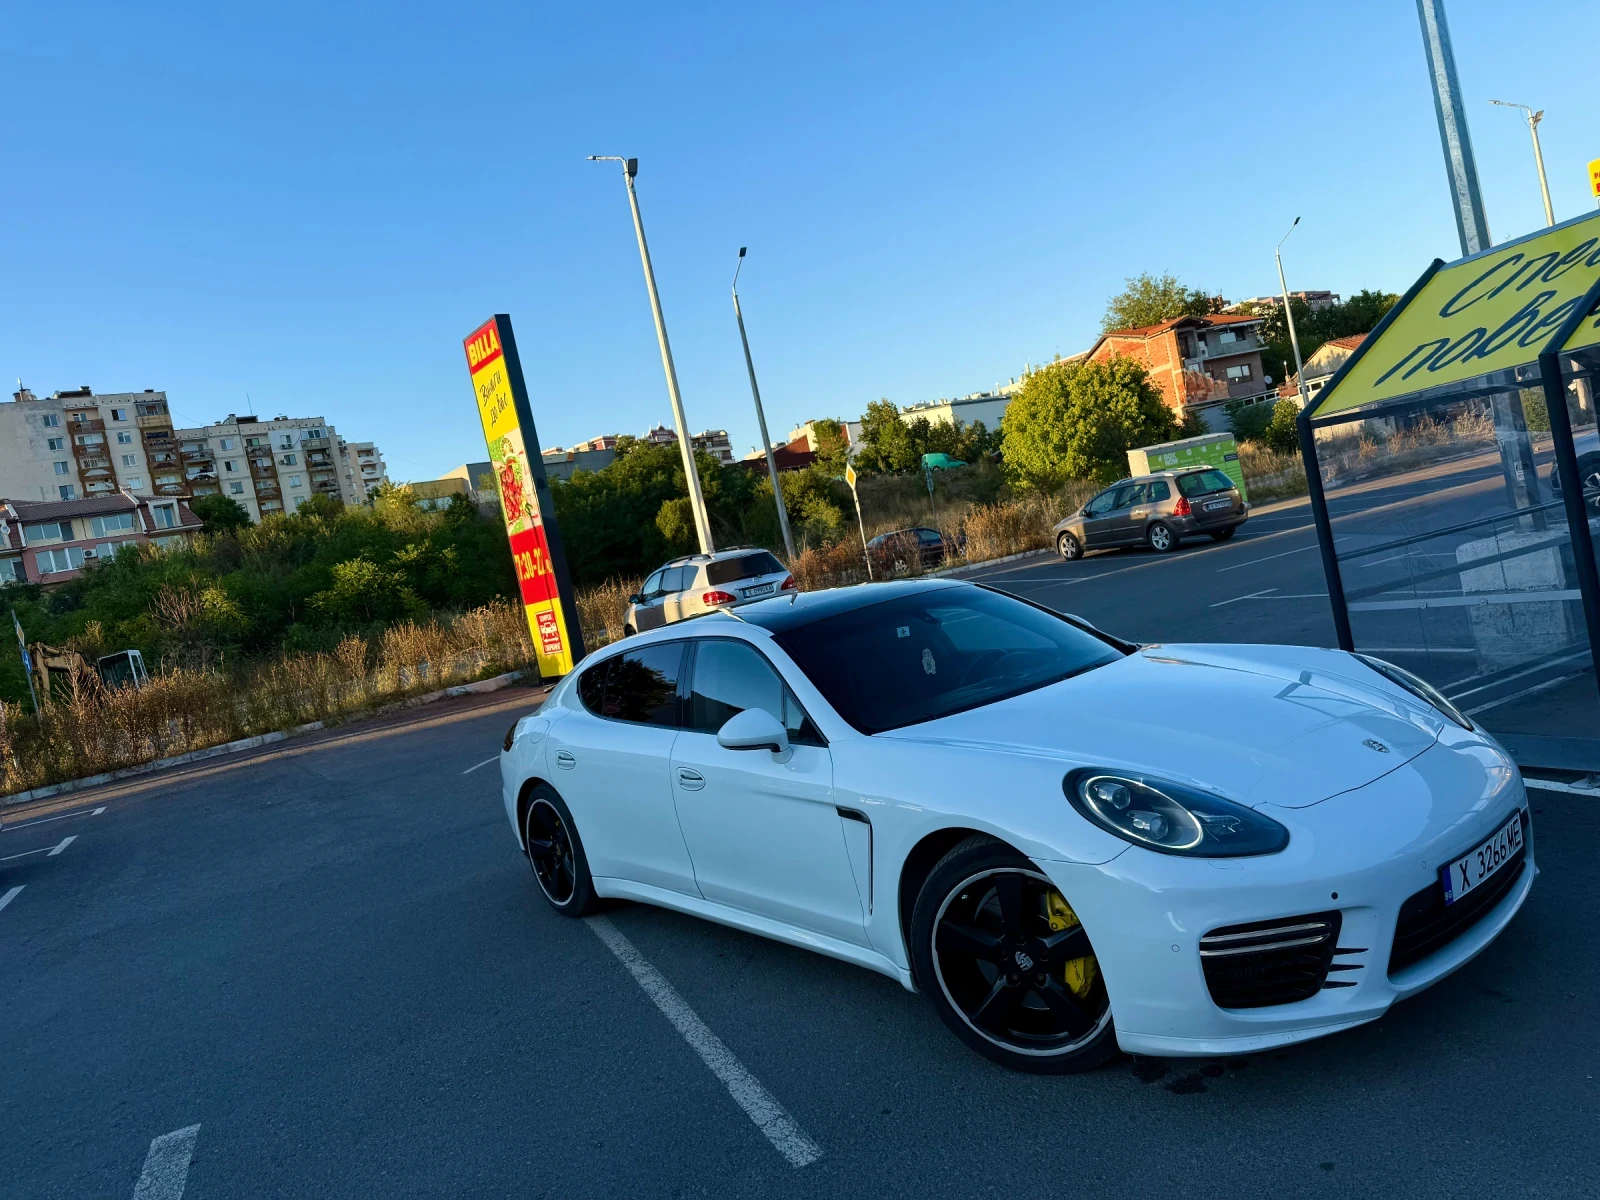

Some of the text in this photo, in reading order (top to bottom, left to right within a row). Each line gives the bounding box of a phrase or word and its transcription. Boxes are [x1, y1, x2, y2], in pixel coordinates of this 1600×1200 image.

[467, 328, 500, 368] BILLA
[1373, 290, 1600, 388] пове
[1163, 452, 1176, 461] BOX
[1164, 458, 1179, 467] NOW
[1459, 816, 1521, 892] X 3266 ME
[1444, 889, 1453, 901] BG
